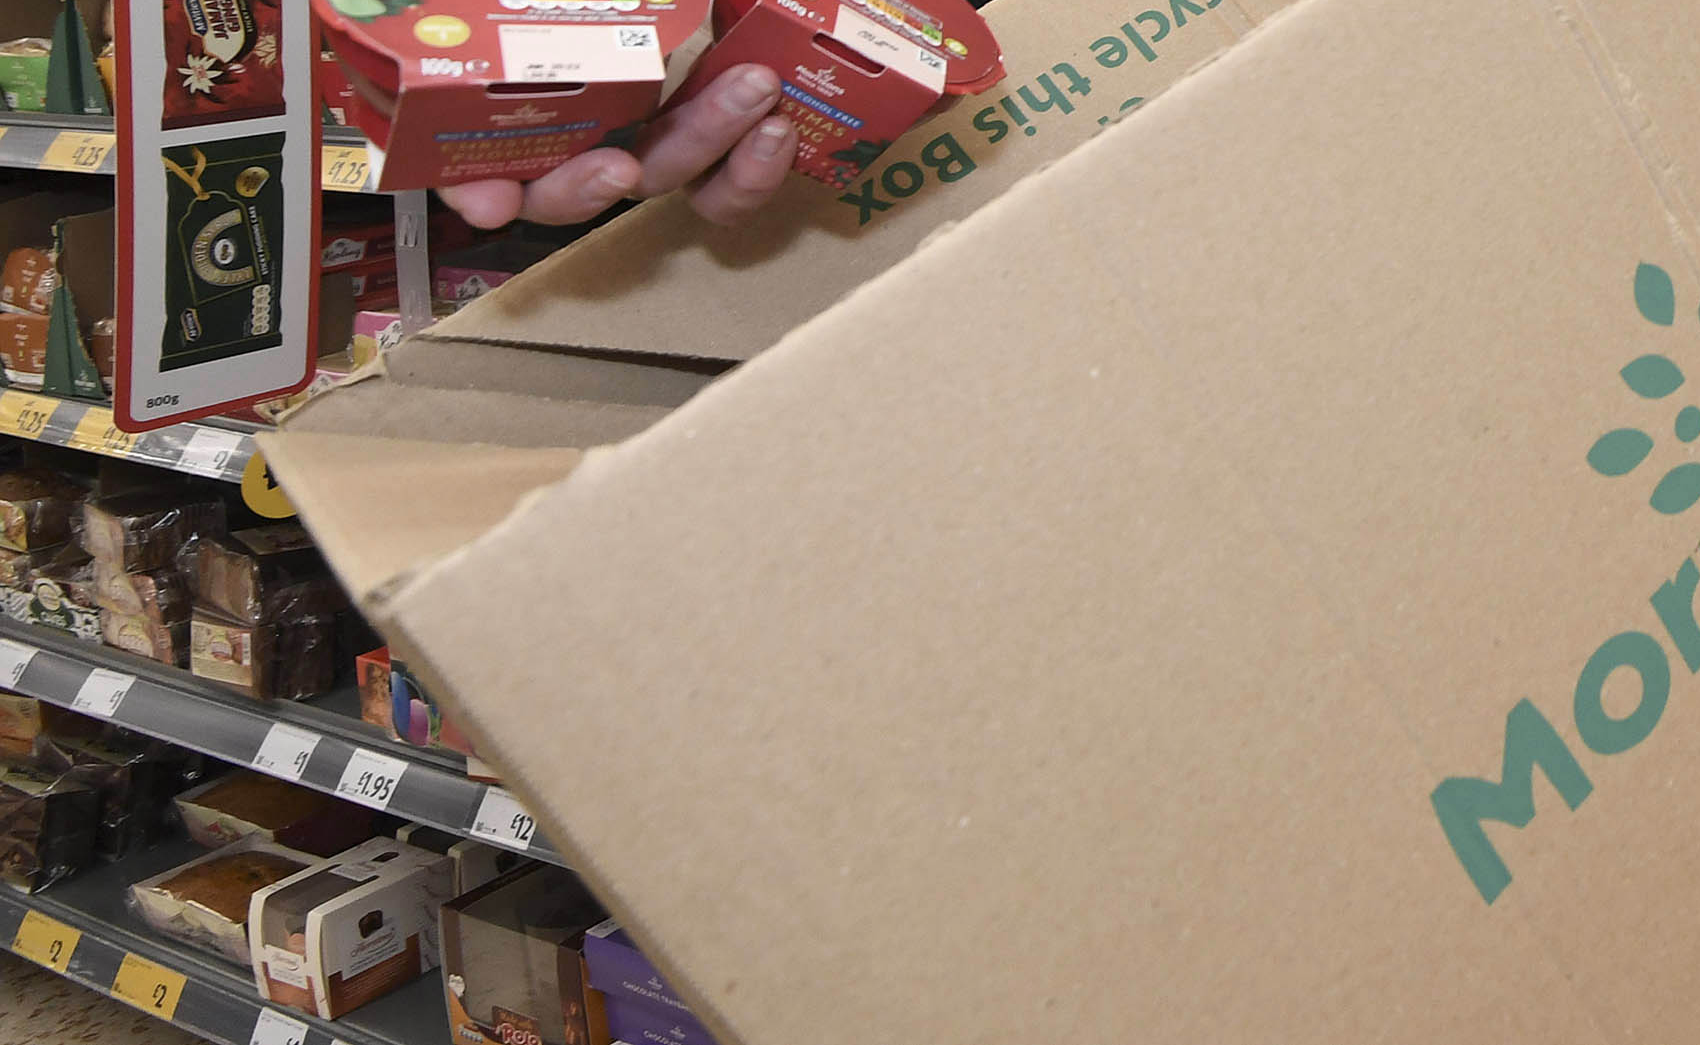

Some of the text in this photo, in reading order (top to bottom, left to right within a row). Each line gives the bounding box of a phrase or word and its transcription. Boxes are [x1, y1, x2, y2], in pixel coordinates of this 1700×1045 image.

[420, 57, 464, 77] 100g
[795, 65, 845, 97] Morrisons
[783, 84, 862, 130] ALCOHOL FREE
[973, 62, 1092, 144] this
[837, 132, 978, 227] Box
[146, 394, 180, 409] 800g
[355, 769, 392, 803] £1.95
[510, 811, 535, 841] £12
[50, 939, 63, 964] £2
[152, 983, 168, 1009] £2
